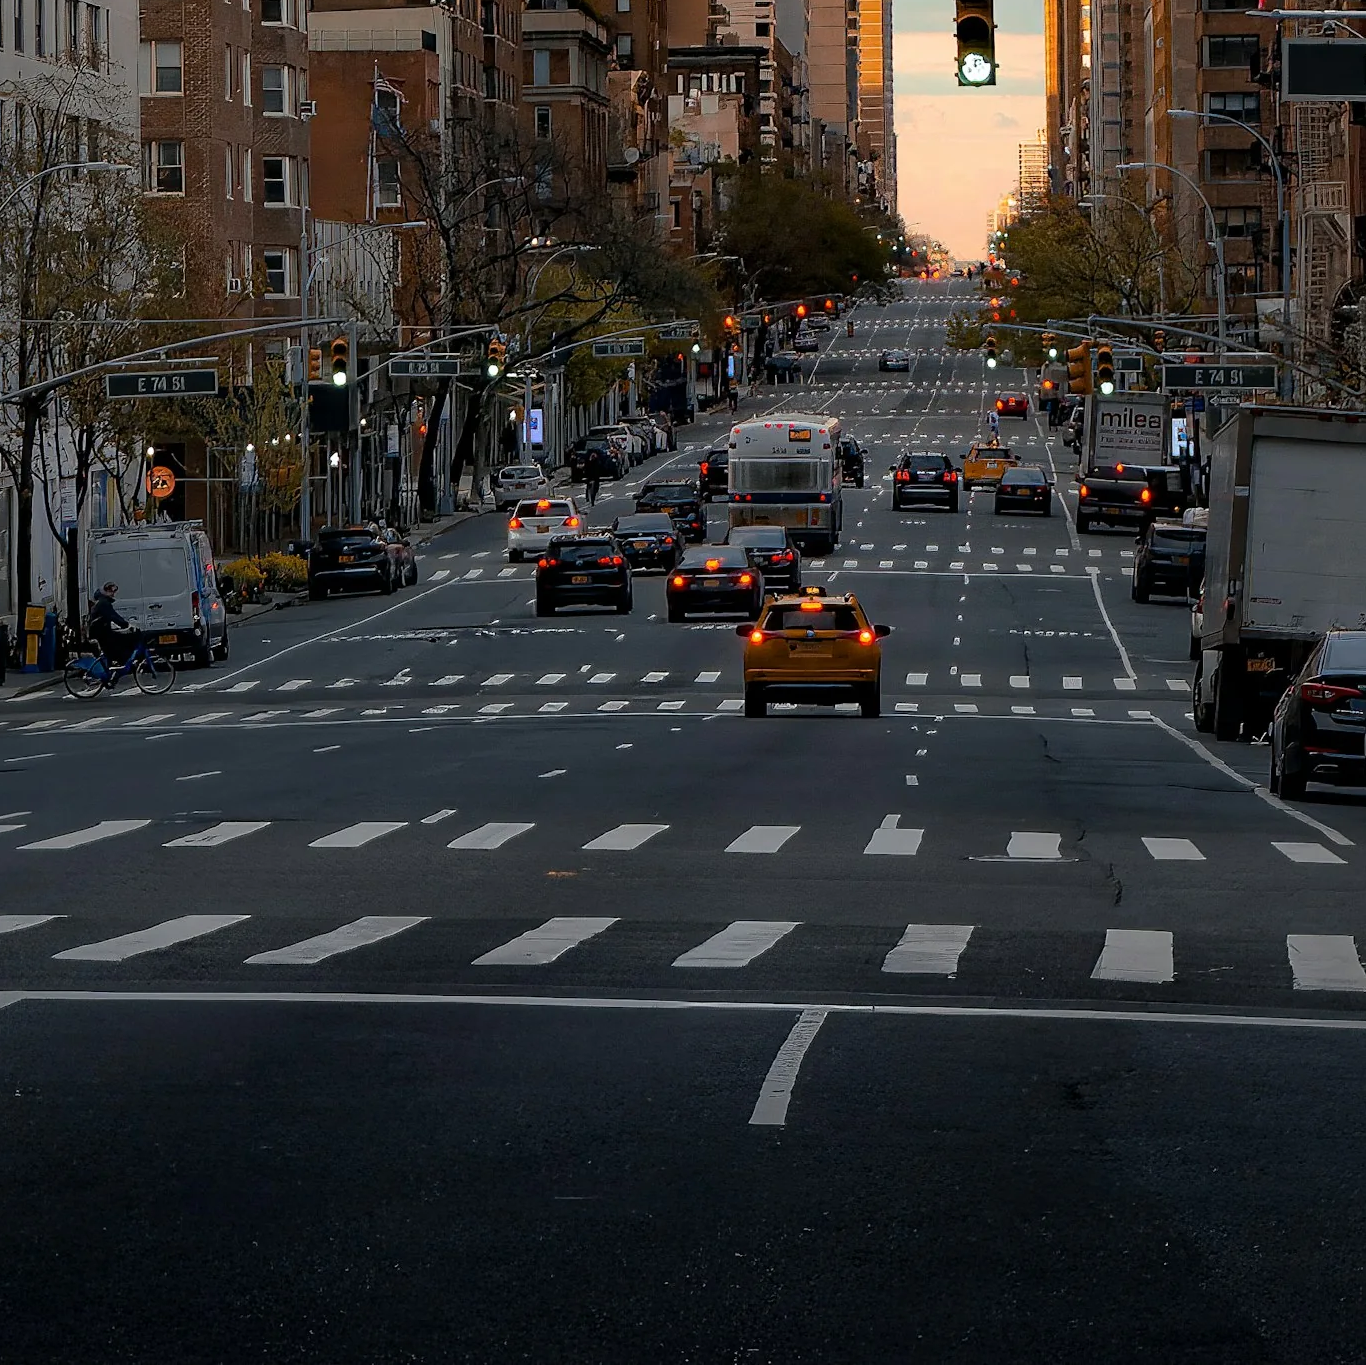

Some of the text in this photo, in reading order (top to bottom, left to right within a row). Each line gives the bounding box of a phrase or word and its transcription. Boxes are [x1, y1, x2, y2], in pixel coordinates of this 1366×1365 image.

[138, 377, 147, 392] E
[151, 376, 167, 391] 74
[1195, 369, 1244, 385] E 74 St
[1101, 407, 1161, 429] milea
